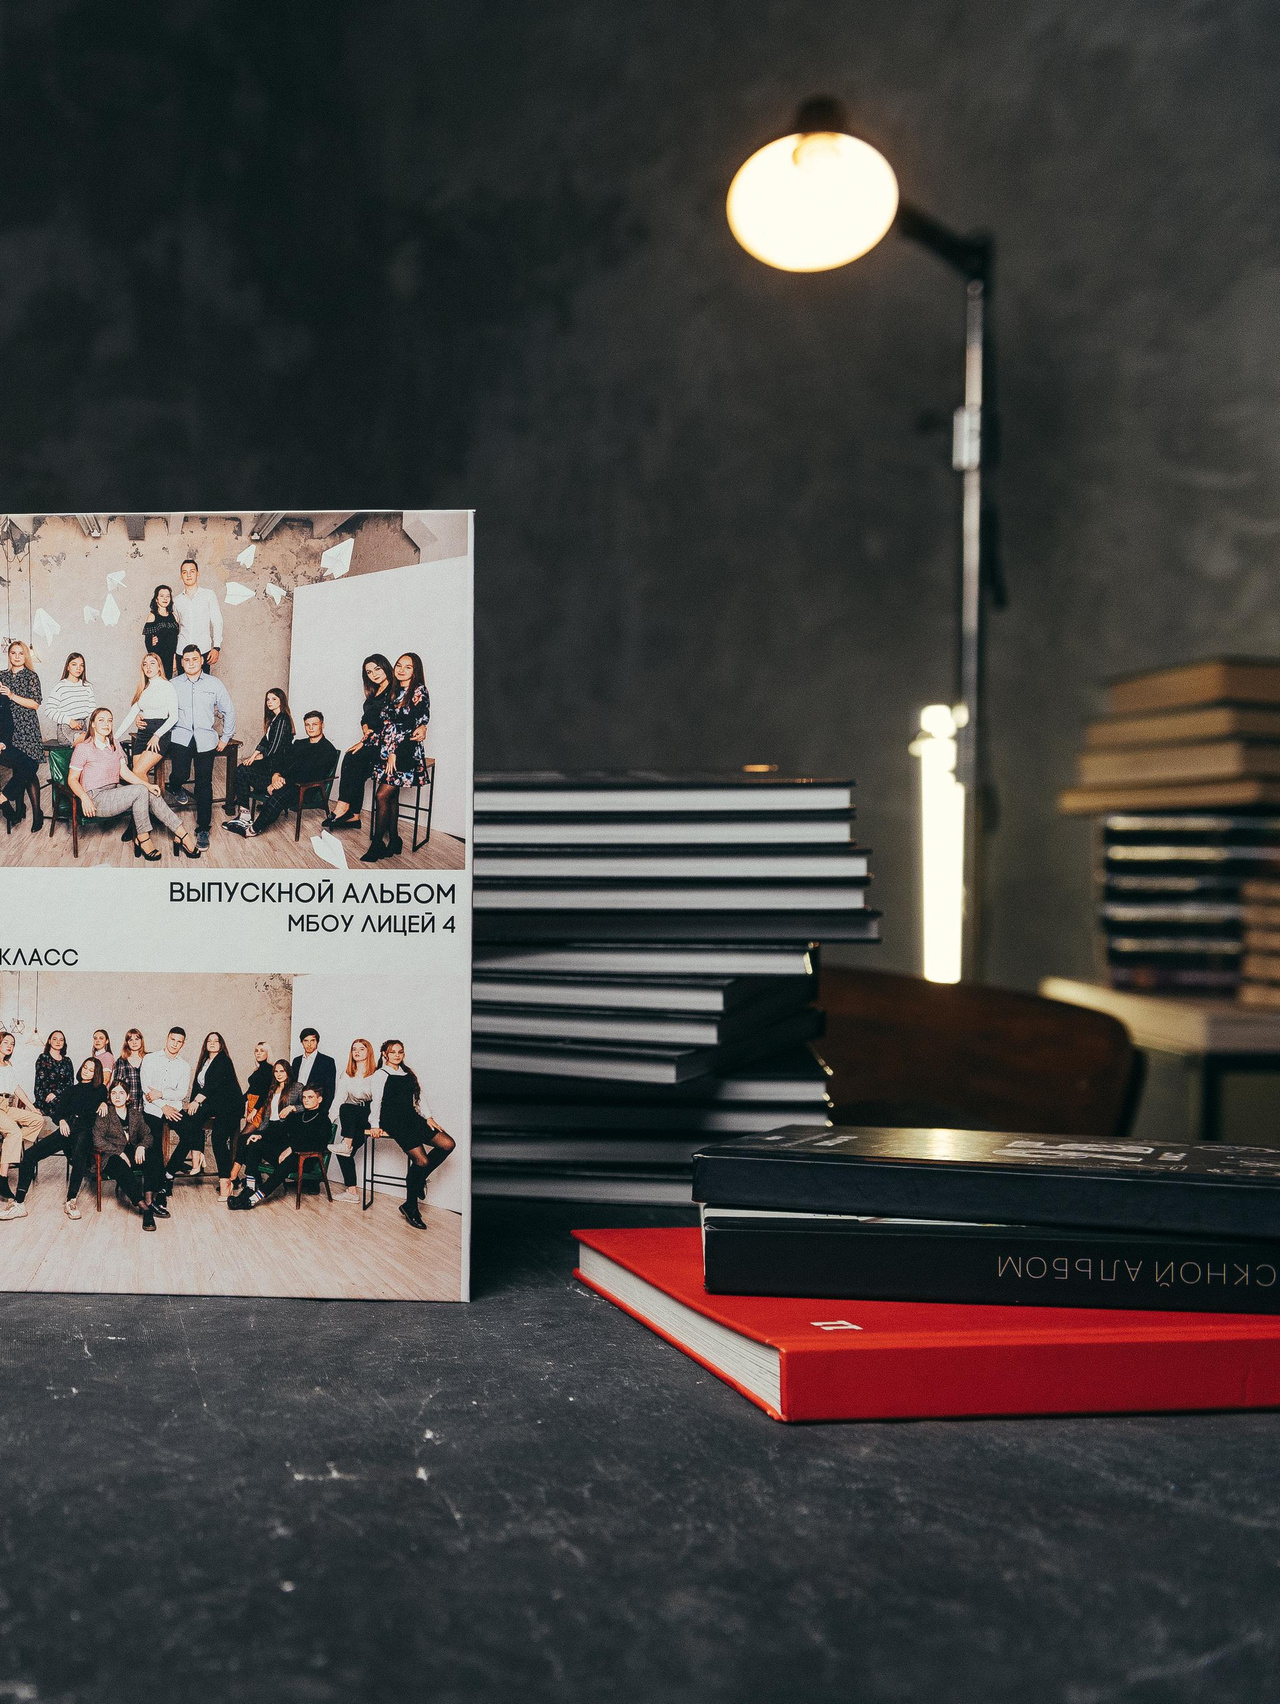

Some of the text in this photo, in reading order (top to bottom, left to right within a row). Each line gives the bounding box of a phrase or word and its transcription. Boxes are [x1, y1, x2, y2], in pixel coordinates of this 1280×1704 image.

[169, 878, 456, 905] ВЫПУСКНОЙ АЛЬБОМ
[288, 911, 456, 937] МБОУ ЛИЦЕЙ 4
[998, 1255, 1277, 1288] СКНОЙ АЛЬБОМ
